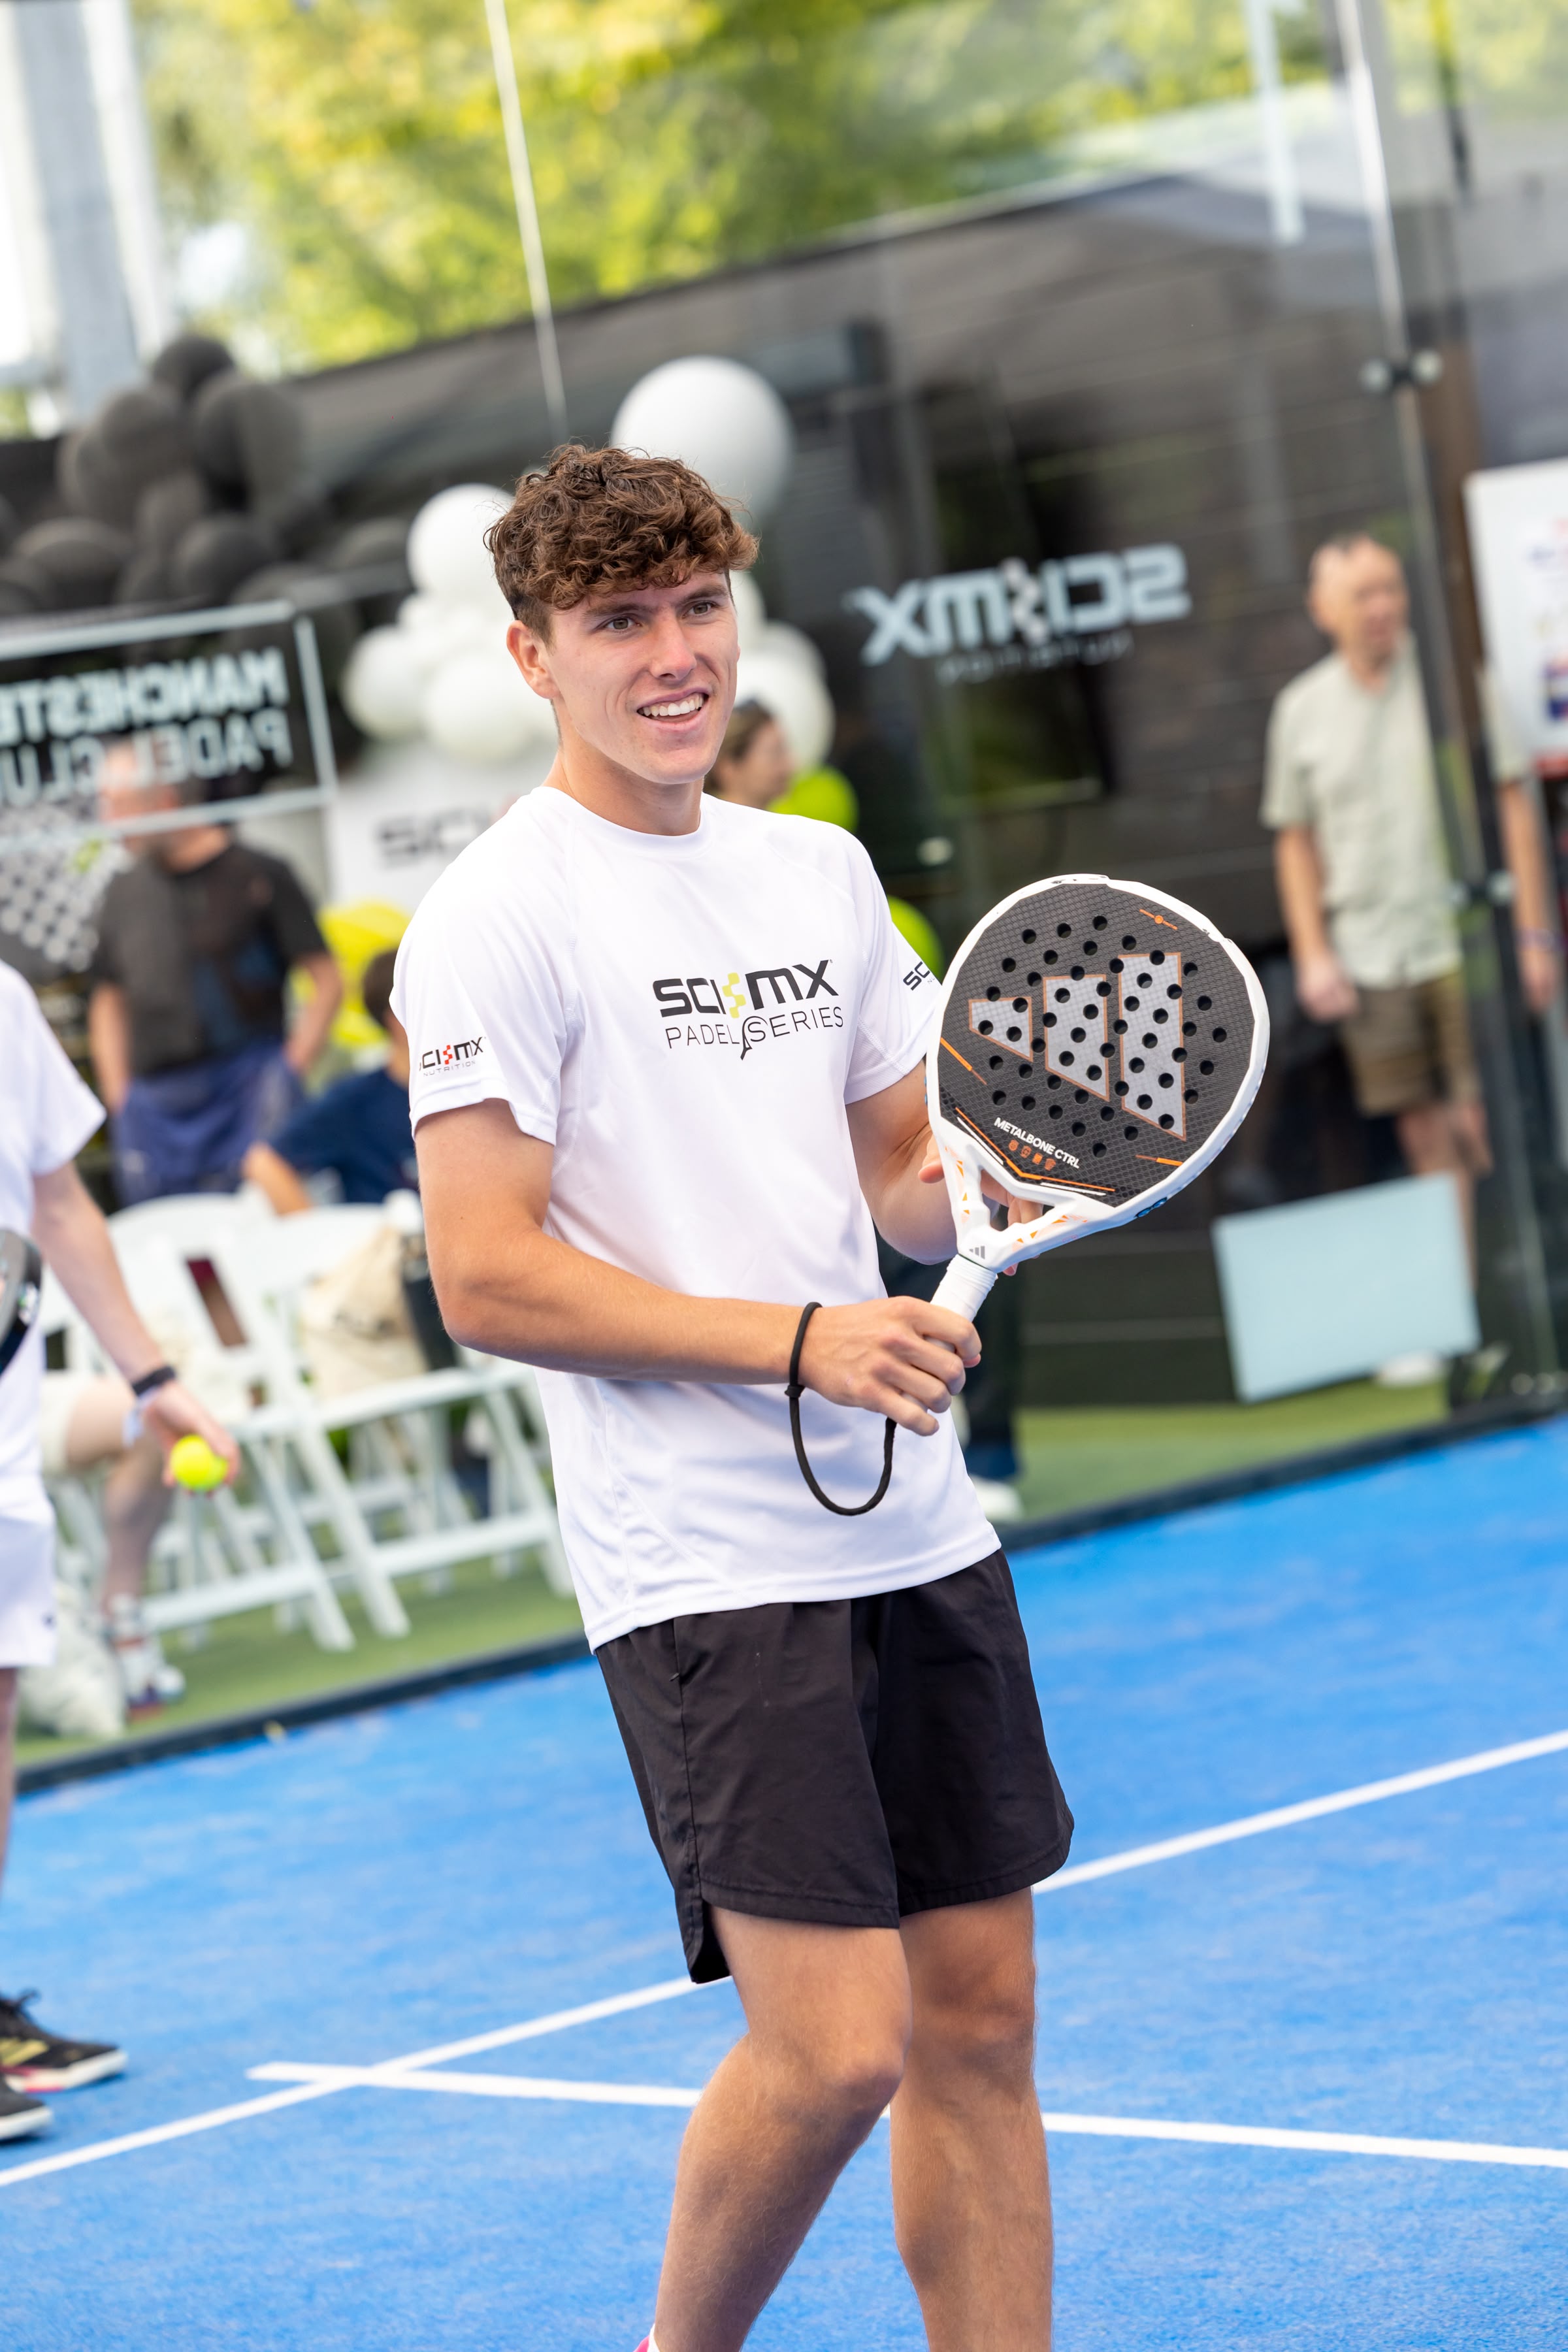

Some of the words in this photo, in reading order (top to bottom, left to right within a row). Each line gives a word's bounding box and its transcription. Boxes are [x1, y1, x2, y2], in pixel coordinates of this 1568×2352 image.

[665, 1024, 740, 1049] PADEL
[747, 1006, 843, 1043] SERIES
[423, 1060, 476, 1077] NUTRITION
[994, 1117, 1056, 1155] METALBONE
[1054, 1149, 1080, 1169] CTRL
